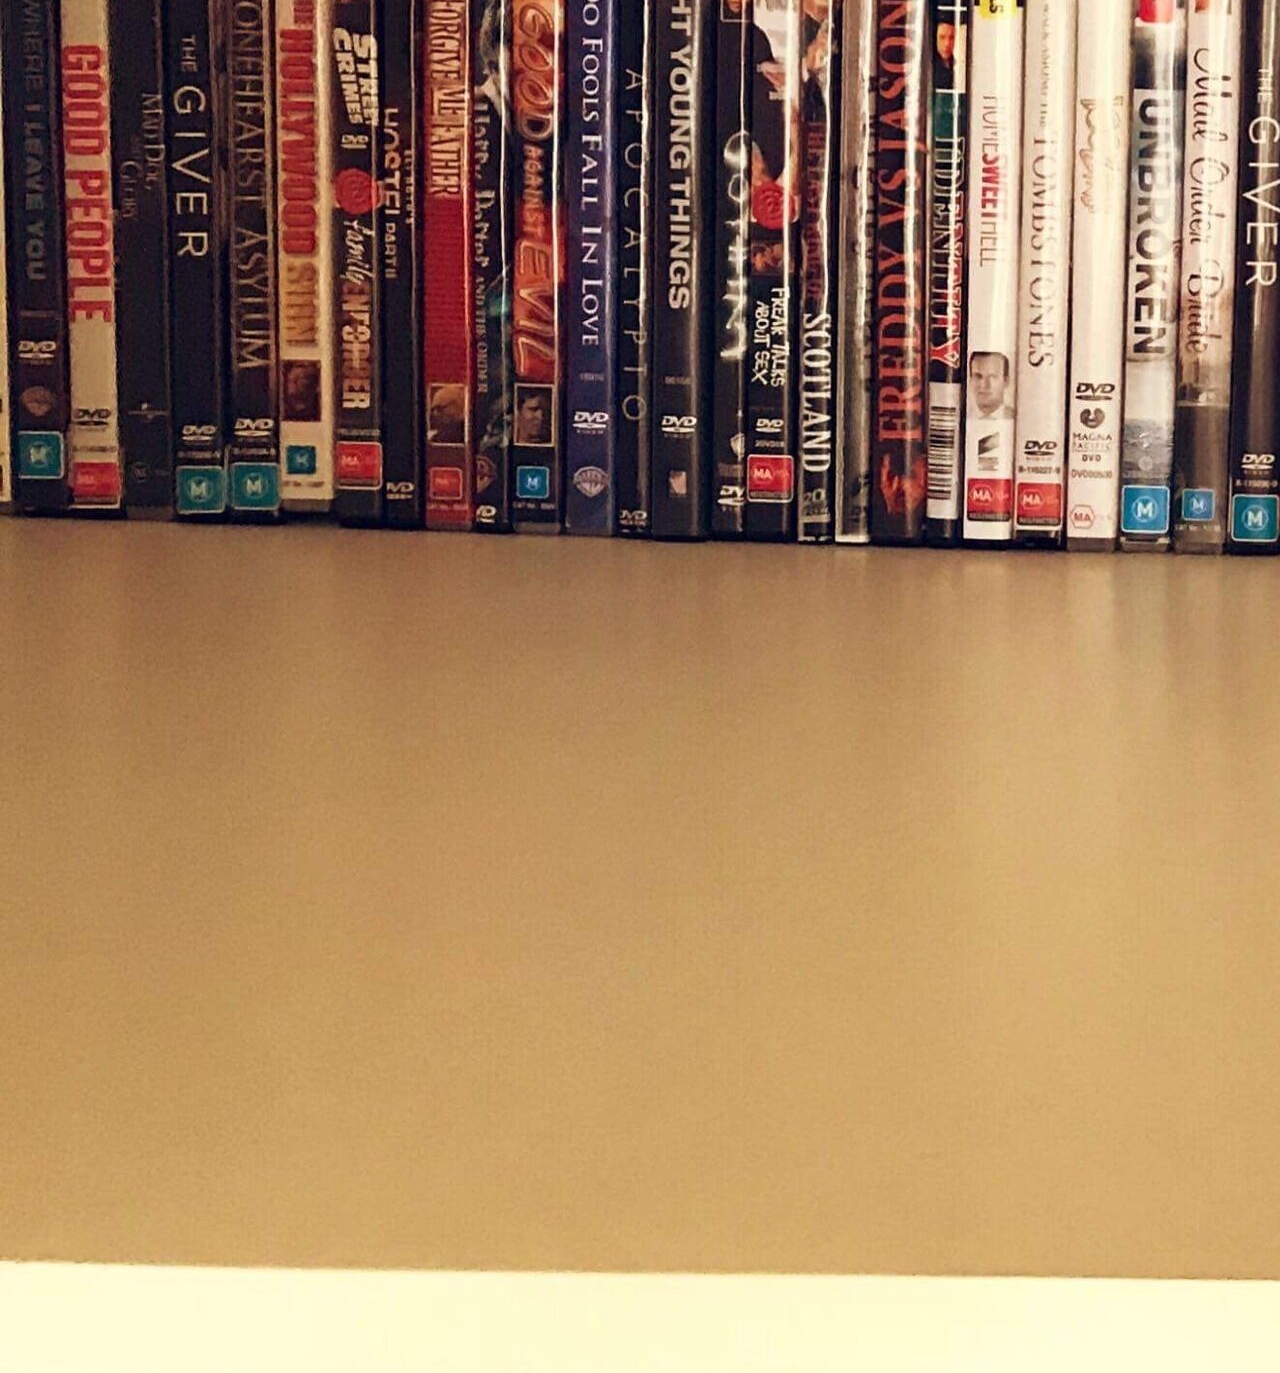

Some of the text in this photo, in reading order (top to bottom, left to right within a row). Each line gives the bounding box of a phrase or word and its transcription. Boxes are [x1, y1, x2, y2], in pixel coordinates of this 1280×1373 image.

[332, 27, 364, 125] CRIMES
[350, 33, 380, 127] STREET
[430, 85, 467, 115] ME
[581, 37, 603, 125] FOOLS
[1256, 68, 1273, 102] THE
[24, 121, 45, 212] LEAVE
[62, 45, 113, 323] GOOD PEOPLE
[171, 36, 211, 258] THE GIVER
[280, 29, 317, 255] HOLLYWOOD
[430, 125, 463, 197] FATHER
[580, 134, 602, 211] FALL
[667, 46, 692, 310] YOUNG THINGS
[515, 3, 558, 377] GOOD AGAINST EVIL
[877, 167, 922, 227] VS
[1134, 97, 1168, 355] UNBROKEN
[1186, 46, 1232, 354] Mail Order Bride
[25, 220, 46, 282] YOU
[344, 219, 377, 287] family
[384, 222, 397, 267] PART
[580, 226, 603, 265] IN
[622, 67, 650, 421] APOCALYPTO
[930, 136, 966, 368] IDENTITY
[1029, 138, 1057, 369] TOMBSTONES
[236, 228, 273, 370] ASYLUM
[580, 278, 603, 347] LOVE
[751, 300, 770, 386] ABOUT SEX
[771, 286, 790, 388] FREAK TALKS
[877, 245, 924, 443] FREDDY
[1076, 382, 1115, 394] DVD
[234, 418, 275, 430] DVD
[573, 411, 609, 423] DVD
[661, 415, 698, 426] DVD
[803, 313, 833, 474] SCOTLAND
[1024, 440, 1058, 450] DVD
[1241, 454, 1276, 464] DVD
